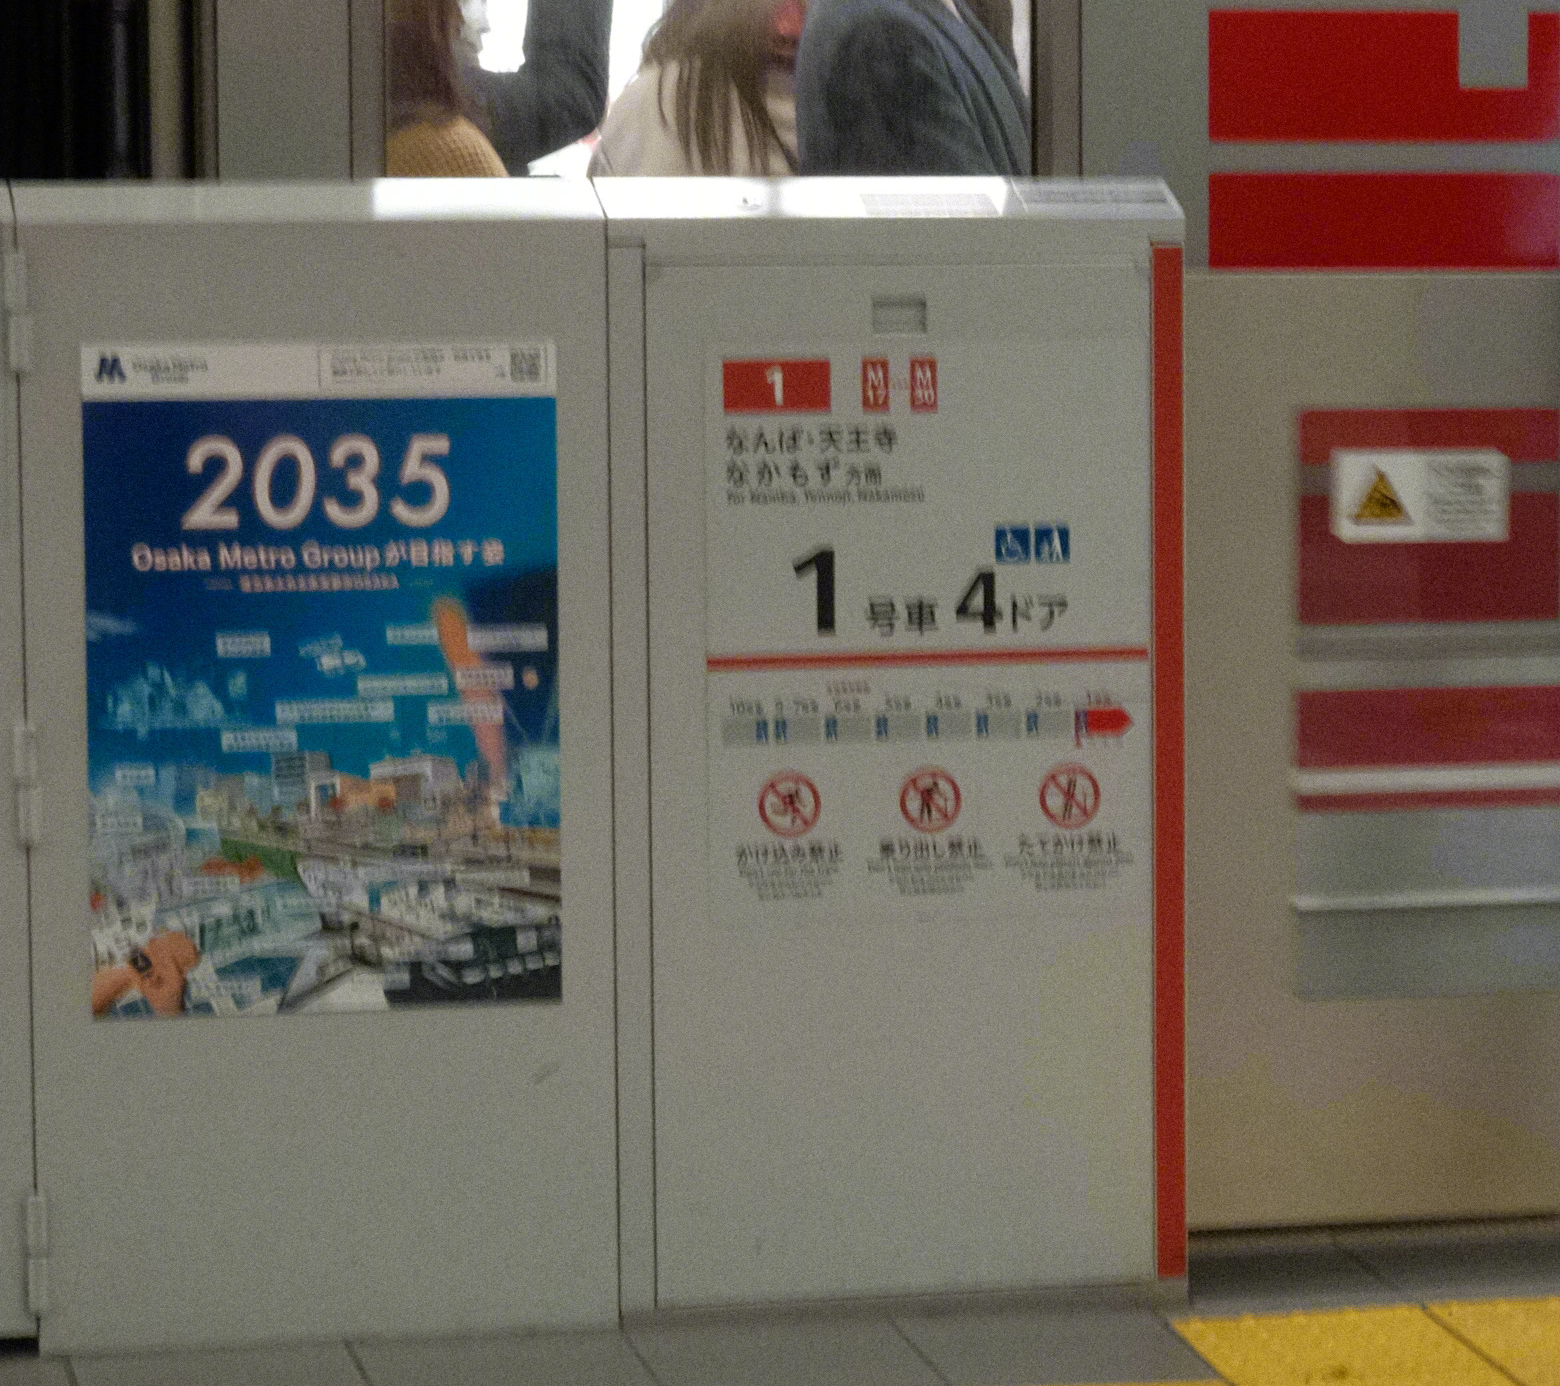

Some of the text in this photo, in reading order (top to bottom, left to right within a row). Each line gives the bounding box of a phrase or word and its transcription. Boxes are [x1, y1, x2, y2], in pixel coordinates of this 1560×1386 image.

[766, 365, 785, 407] 1
[181, 432, 452, 530] 2035
[131, 542, 212, 572] Osaka
[218, 541, 296, 571] Metro
[300, 539, 381, 572] Group
